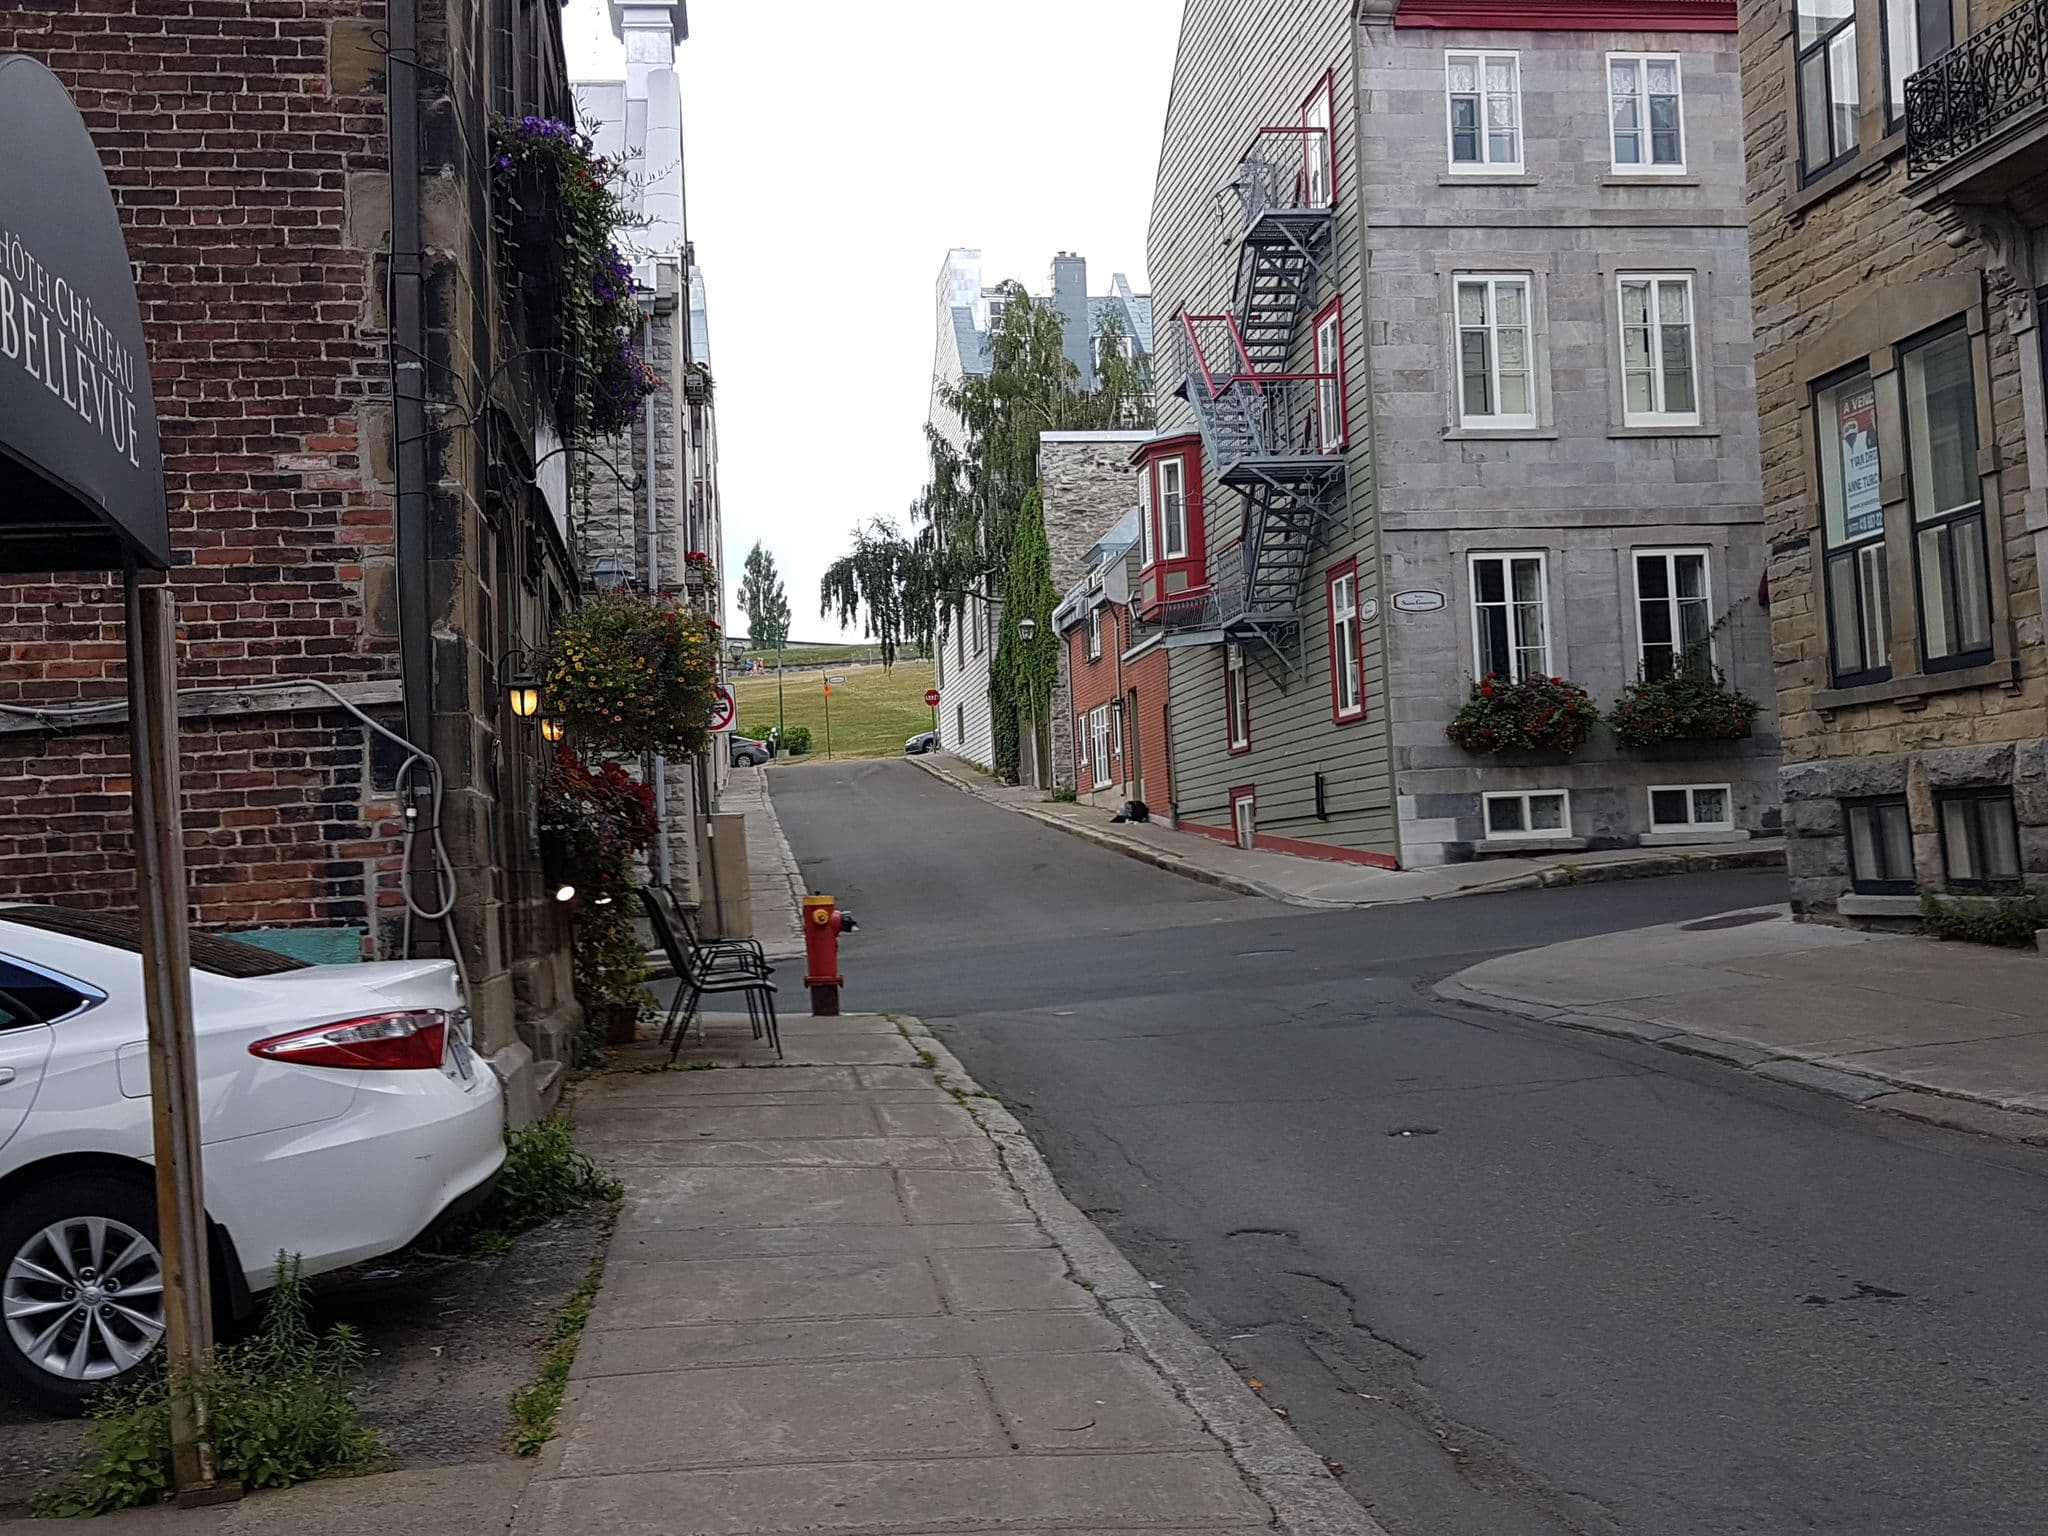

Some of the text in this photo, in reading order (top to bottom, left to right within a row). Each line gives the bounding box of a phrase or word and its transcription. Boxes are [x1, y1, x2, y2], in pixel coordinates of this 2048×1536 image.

[0, 230, 134, 394] HÔTEL CHÂTEAU
[0, 274, 140, 468] BELLEVUE
